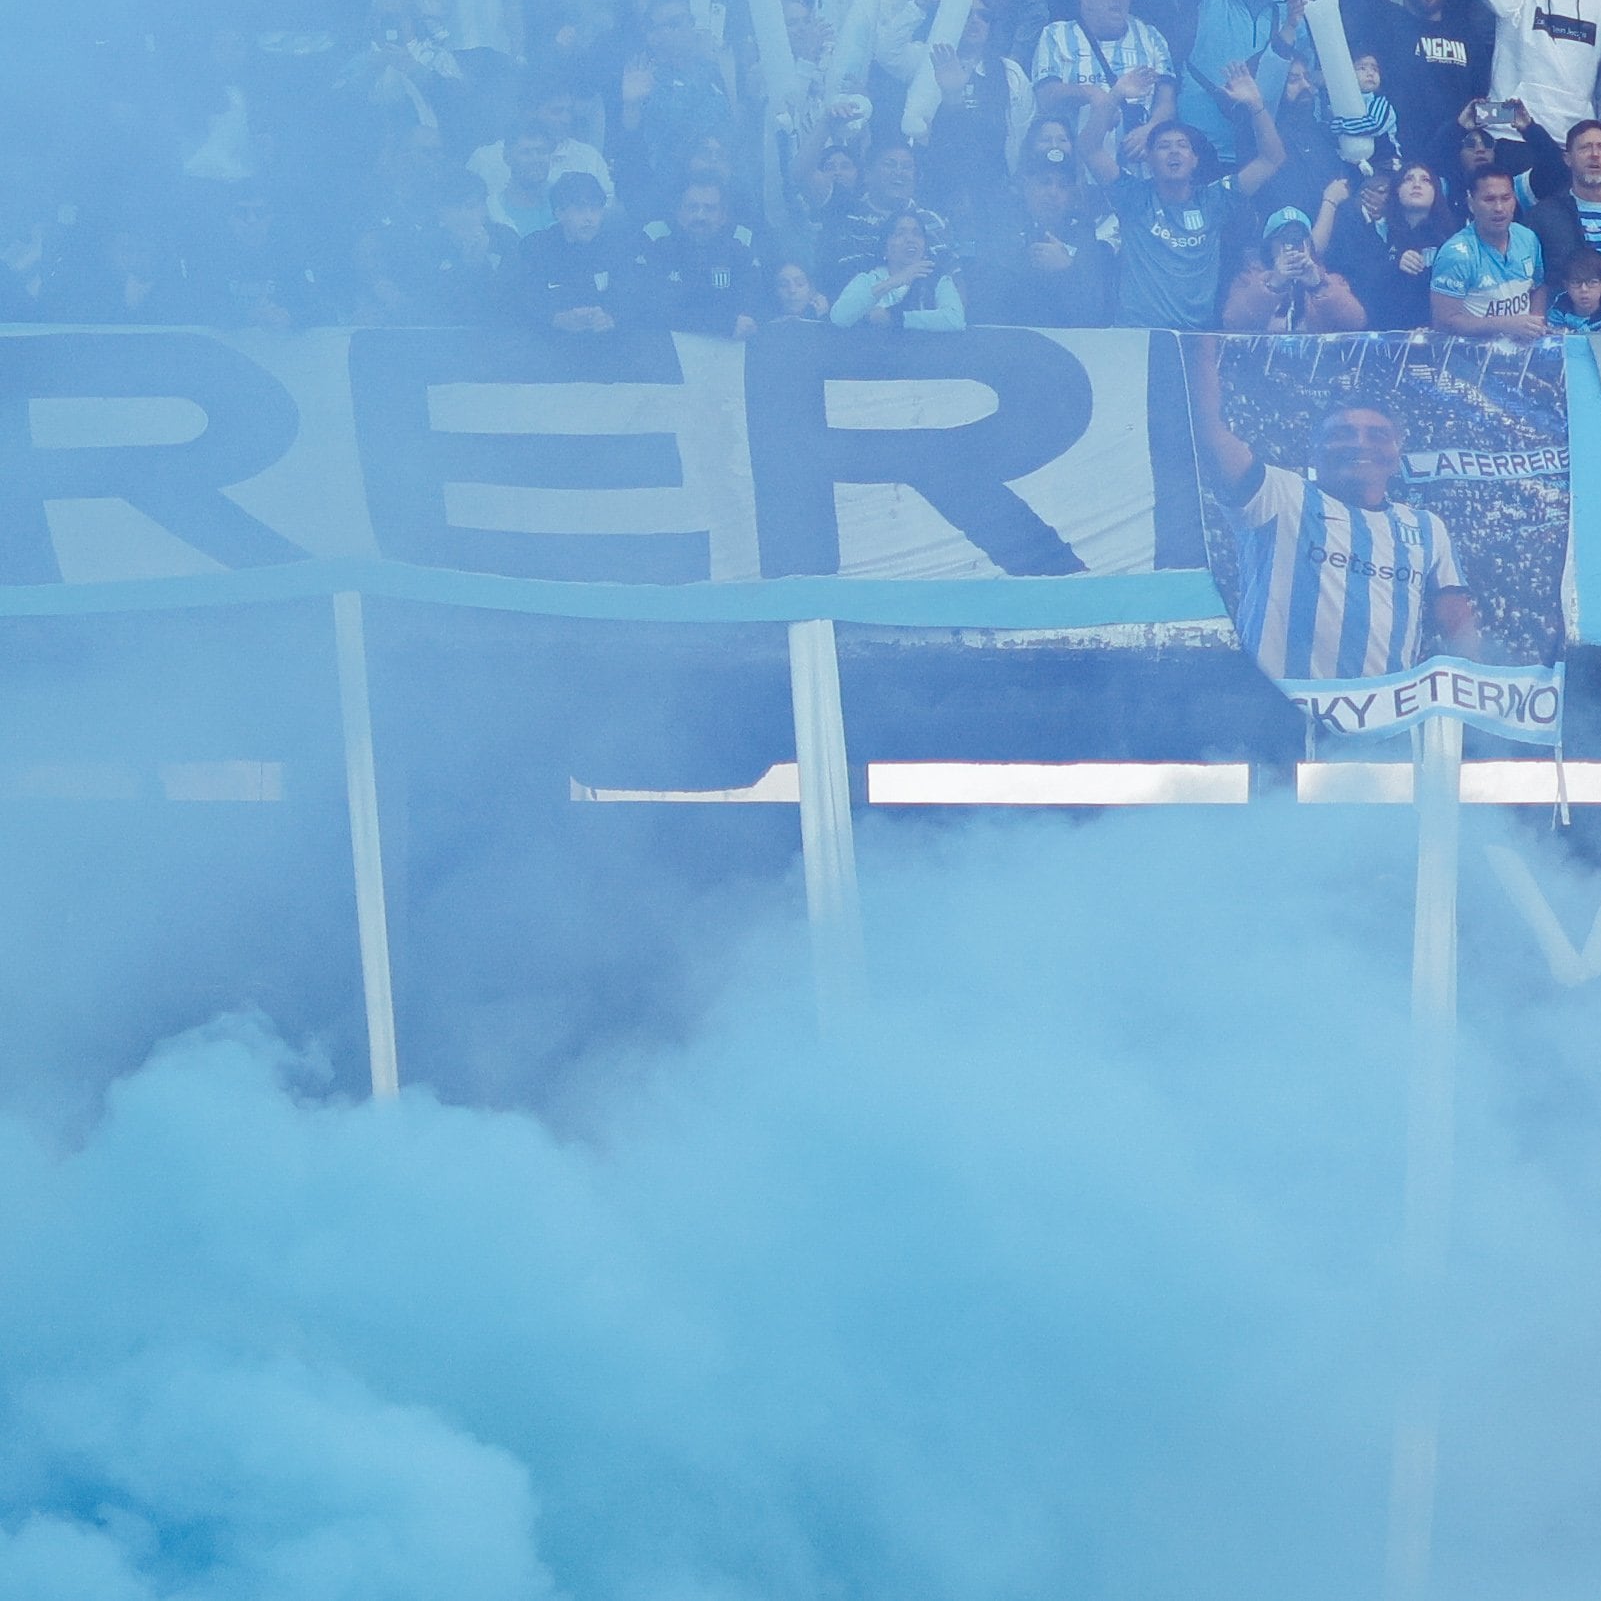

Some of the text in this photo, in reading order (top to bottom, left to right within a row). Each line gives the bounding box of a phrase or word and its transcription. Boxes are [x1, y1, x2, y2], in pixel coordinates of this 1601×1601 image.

[1076, 72, 1110, 86] bets
[1150, 222, 1207, 249] besson
[1485, 291, 1530, 318] AEROS
[0, 327, 1212, 587] RER
[1308, 540, 1424, 587] betsson
[1293, 669, 1560, 734] KY ETERNO
